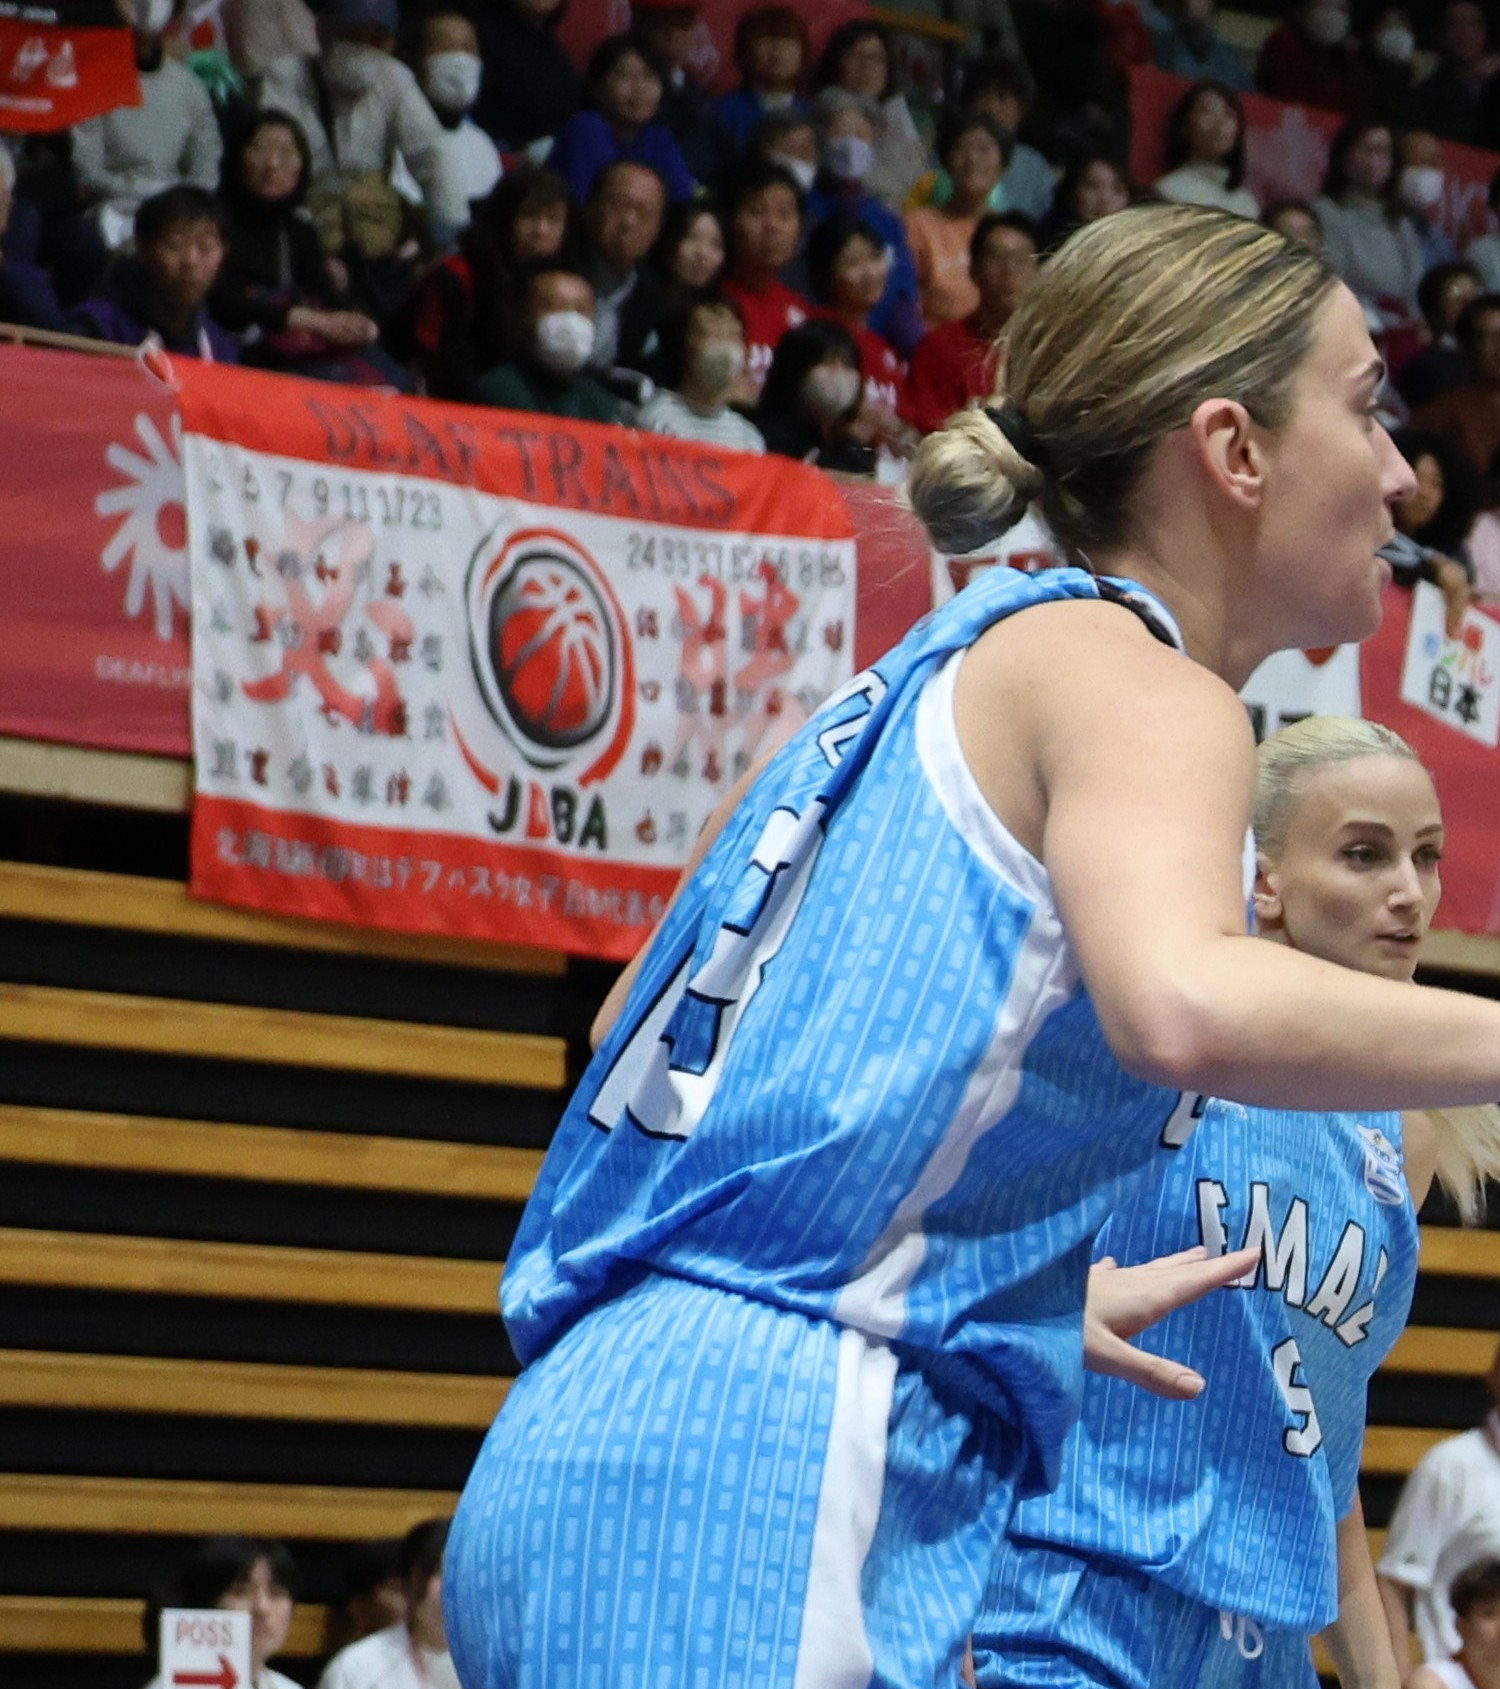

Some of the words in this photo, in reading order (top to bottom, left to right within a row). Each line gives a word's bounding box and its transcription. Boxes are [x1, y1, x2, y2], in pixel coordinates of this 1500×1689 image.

[306, 397, 474, 487] DEAF
[496, 428, 733, 524] TRAINS
[409, 490, 443, 532] 23
[627, 530, 655, 571] 24
[1430, 662, 1482, 724] 日本
[176, 1617, 233, 1648] POSS
